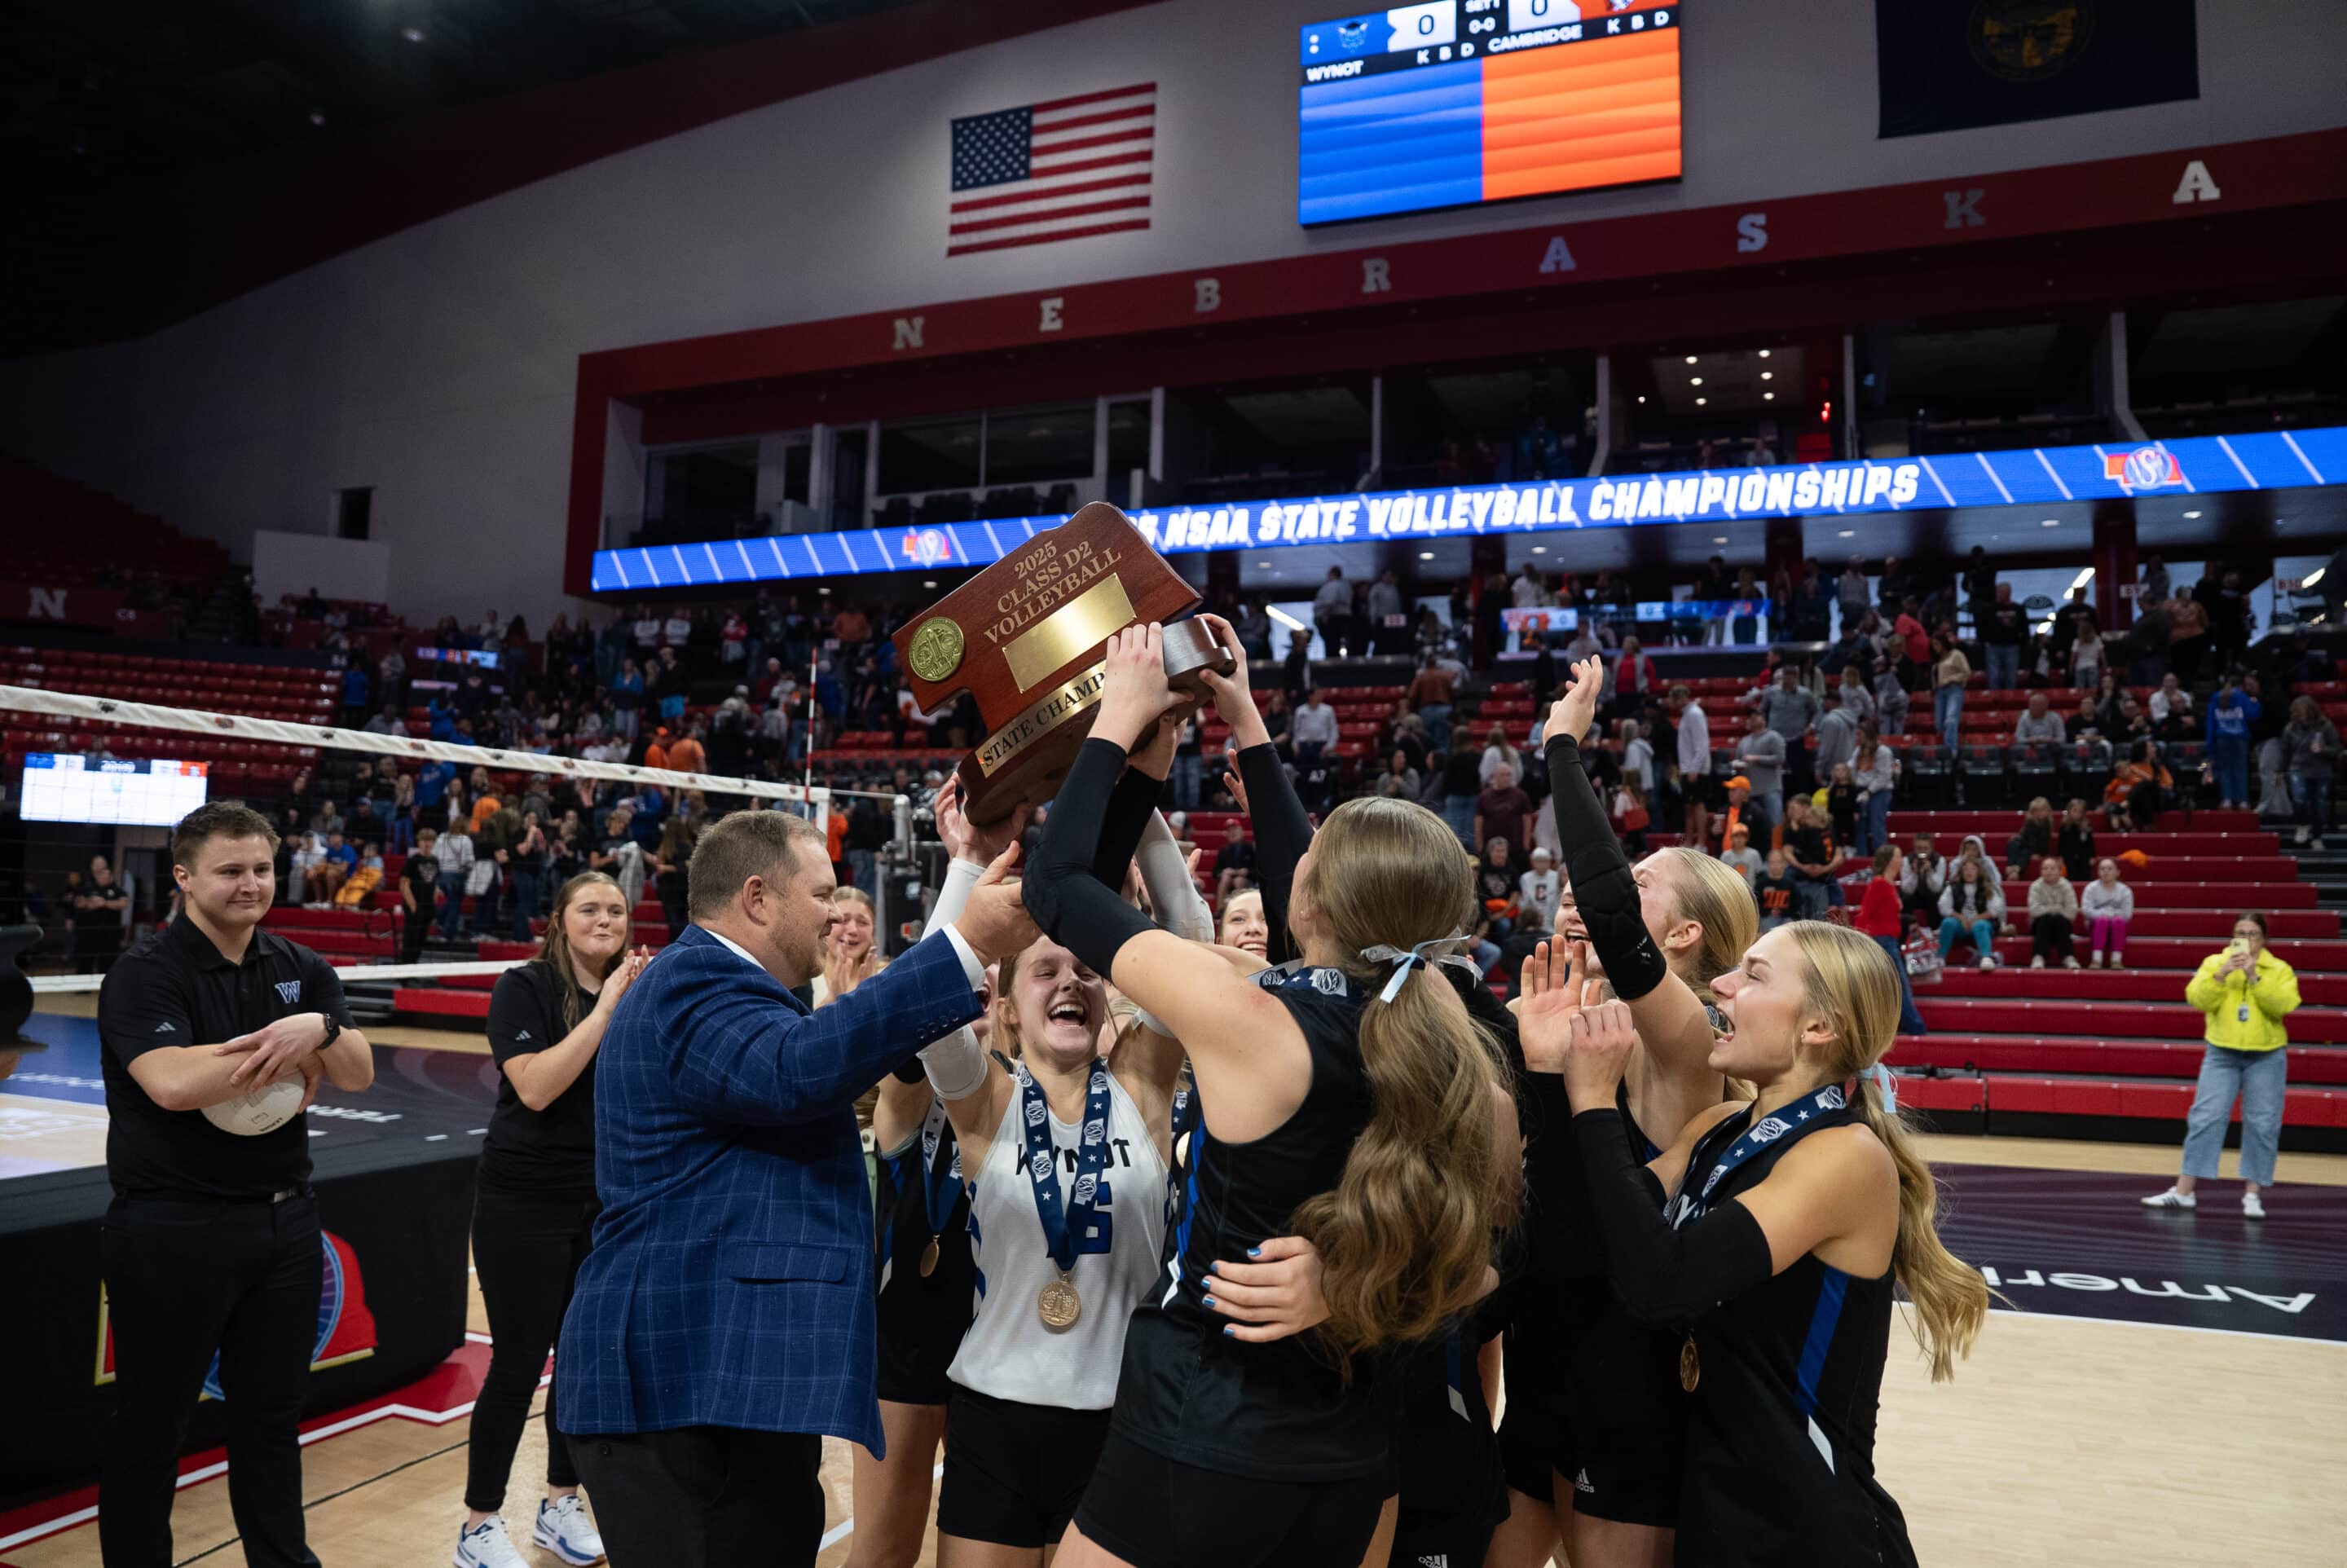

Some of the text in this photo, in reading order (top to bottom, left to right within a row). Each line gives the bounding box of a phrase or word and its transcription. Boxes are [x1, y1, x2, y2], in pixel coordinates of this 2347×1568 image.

[1419, 15, 1434, 35] 0
[1469, 17, 1496, 33] 0-0
[1488, 11, 1669, 52] CAMBRIDGE K B D
[1306, 42, 1474, 81] WYNOT K B D
[1164, 509, 1249, 547] NSAA
[1257, 500, 1360, 540] STATE
[1368, 487, 1576, 535] VOLLEYBALL
[1588, 464, 1920, 522] CHAMPIONSHIPS
[997, 540, 1092, 613] CLASS D2
[1015, 540, 1057, 579] 2025
[29, 588, 67, 619] N
[984, 547, 1122, 644] VOLLEYBALL
[983, 719, 1034, 769] STATE
[275, 980, 301, 1003] W
